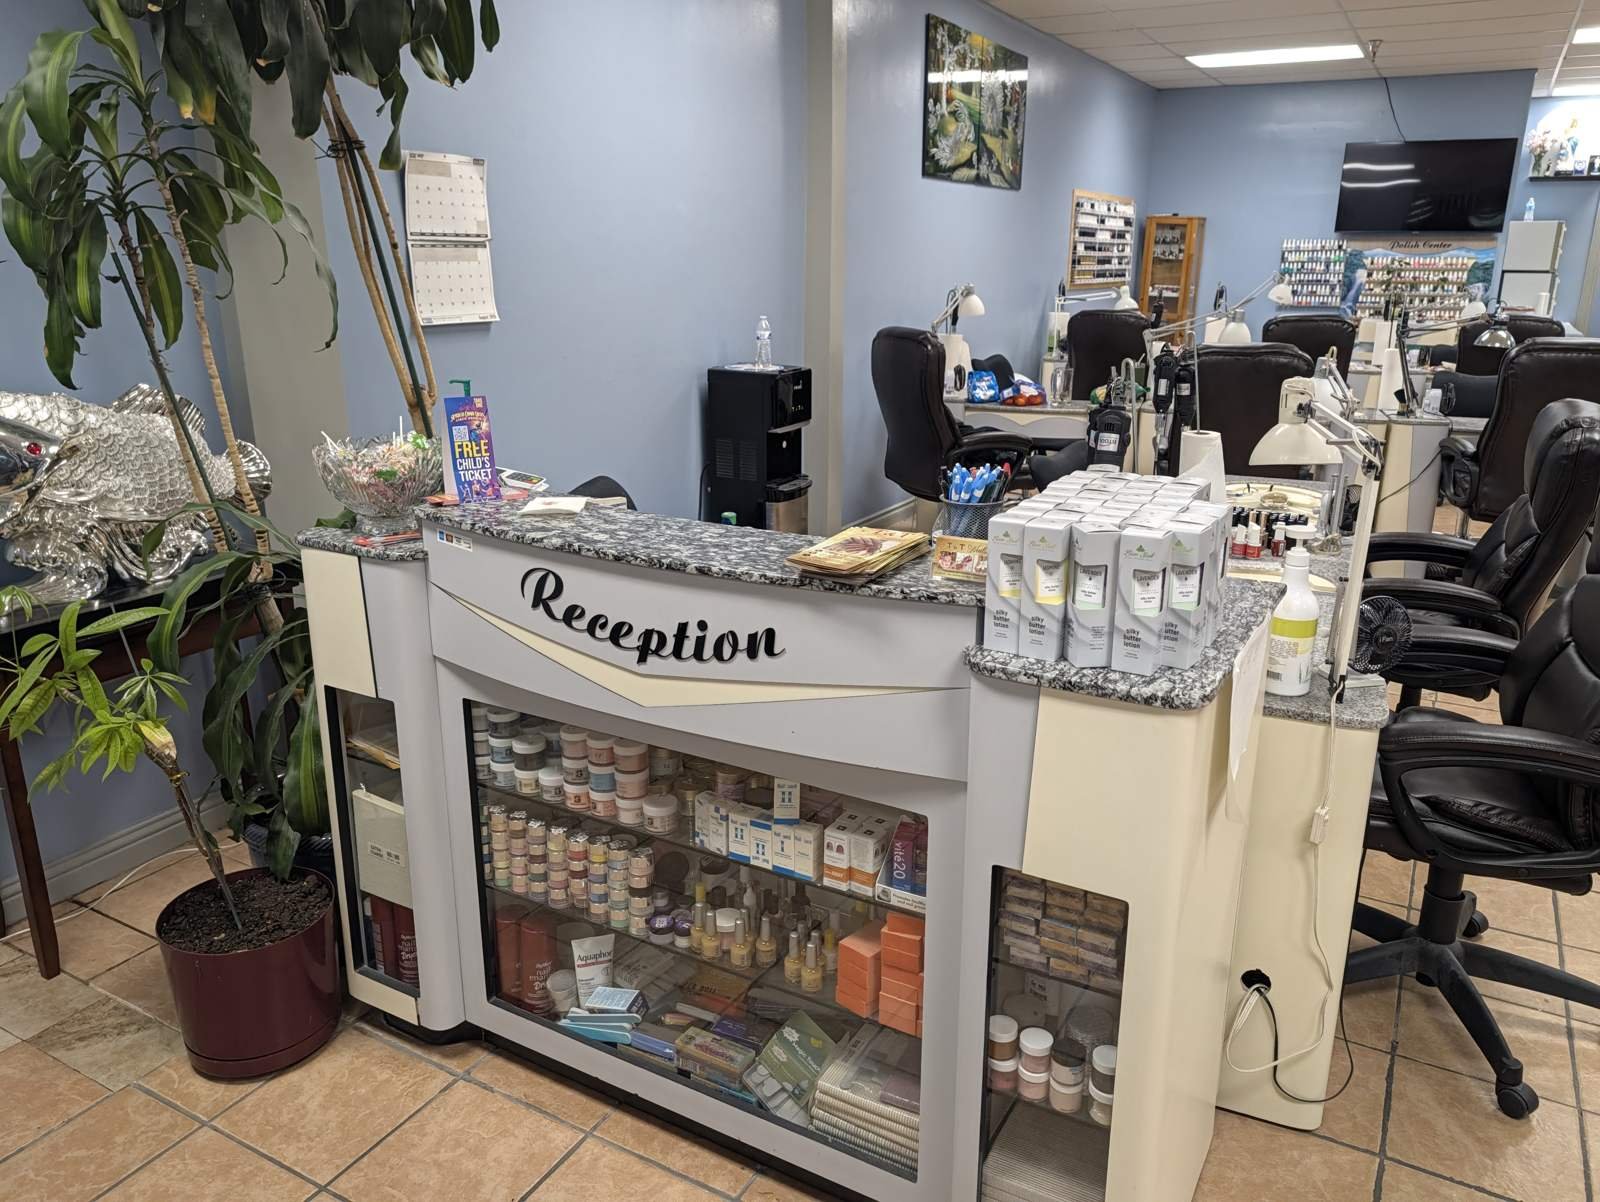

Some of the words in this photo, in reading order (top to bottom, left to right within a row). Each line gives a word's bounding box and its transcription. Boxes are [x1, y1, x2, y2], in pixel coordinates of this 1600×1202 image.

[1389, 240, 1420, 251] Polish
[1422, 240, 1452, 249] Center
[454, 440, 490, 458] FREE
[456, 456, 491, 470] CHILD'S
[459, 469, 493, 482] TICKET
[520, 567, 786, 665] Reception
[1123, 634, 1141, 642] butter
[1126, 628, 1140, 636] silky
[1123, 641, 1141, 649] lotion
[576, 949, 612, 964] Aquaphor
